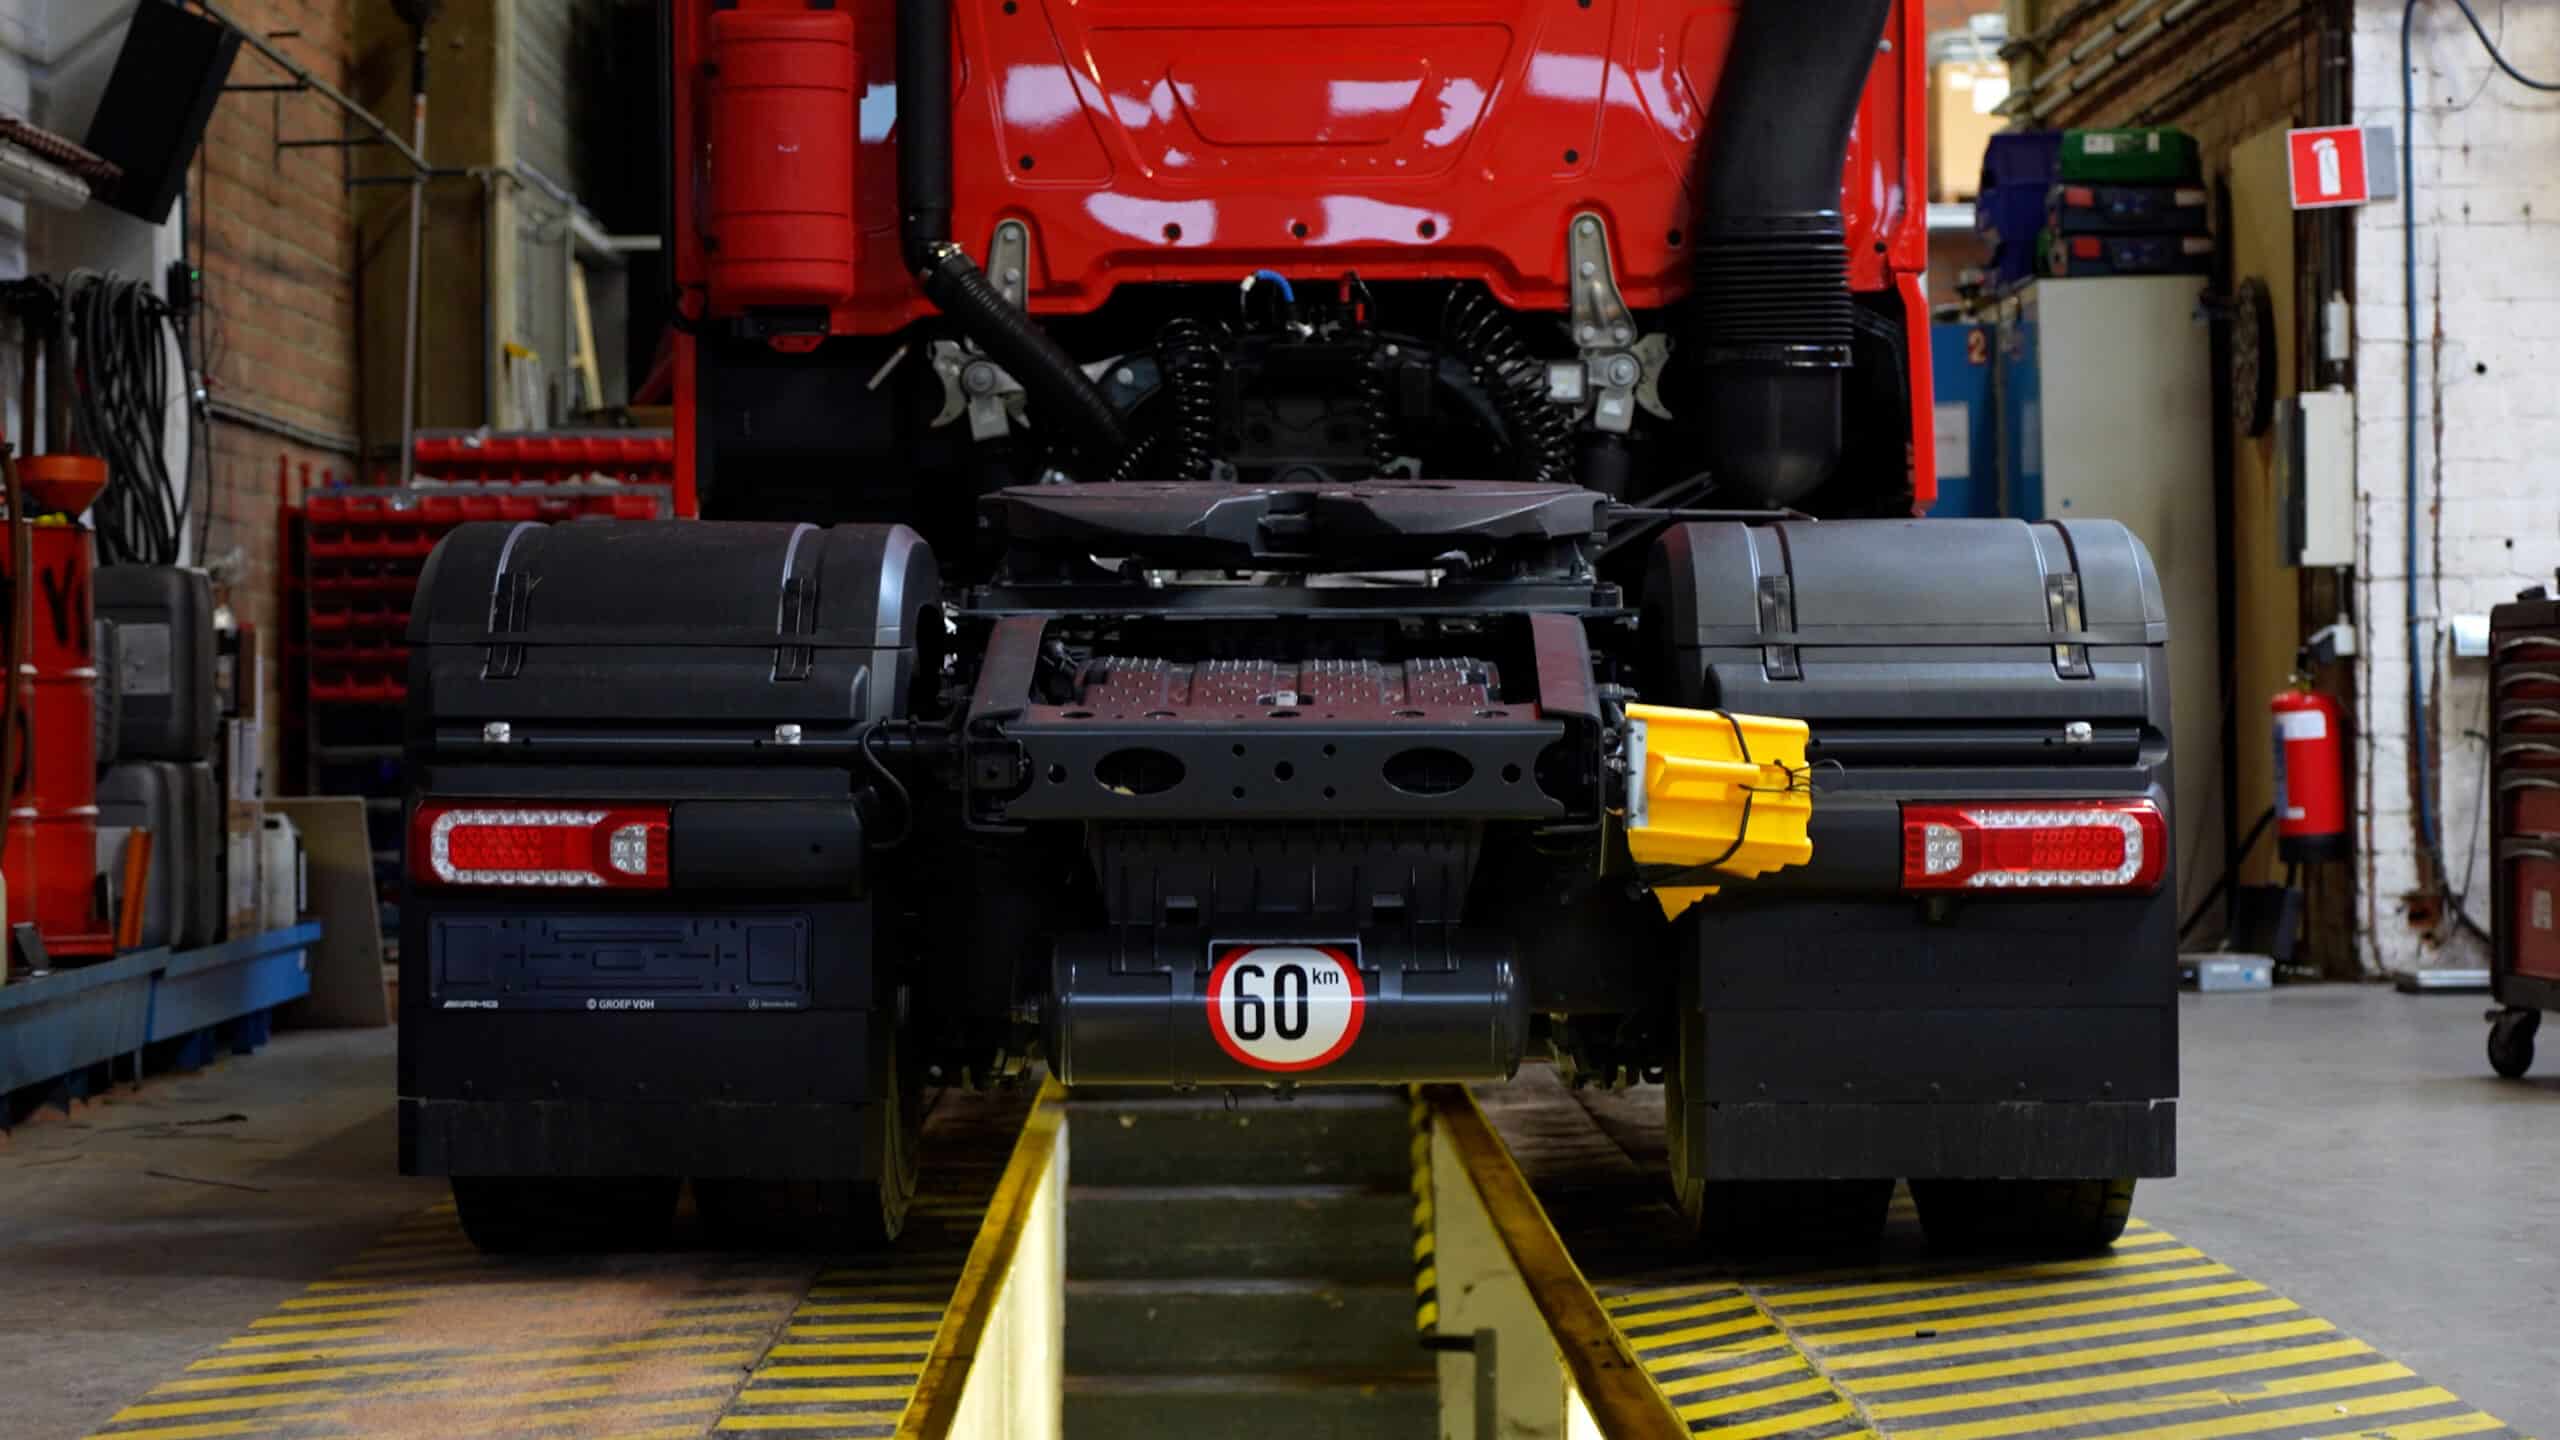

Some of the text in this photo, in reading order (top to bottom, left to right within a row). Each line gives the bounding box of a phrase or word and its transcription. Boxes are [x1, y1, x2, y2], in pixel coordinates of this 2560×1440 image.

[1968, 328, 1987, 364] 2
[599, 999, 655, 1009] GROEP VDH
[1234, 964, 1339, 1041] 60 km
